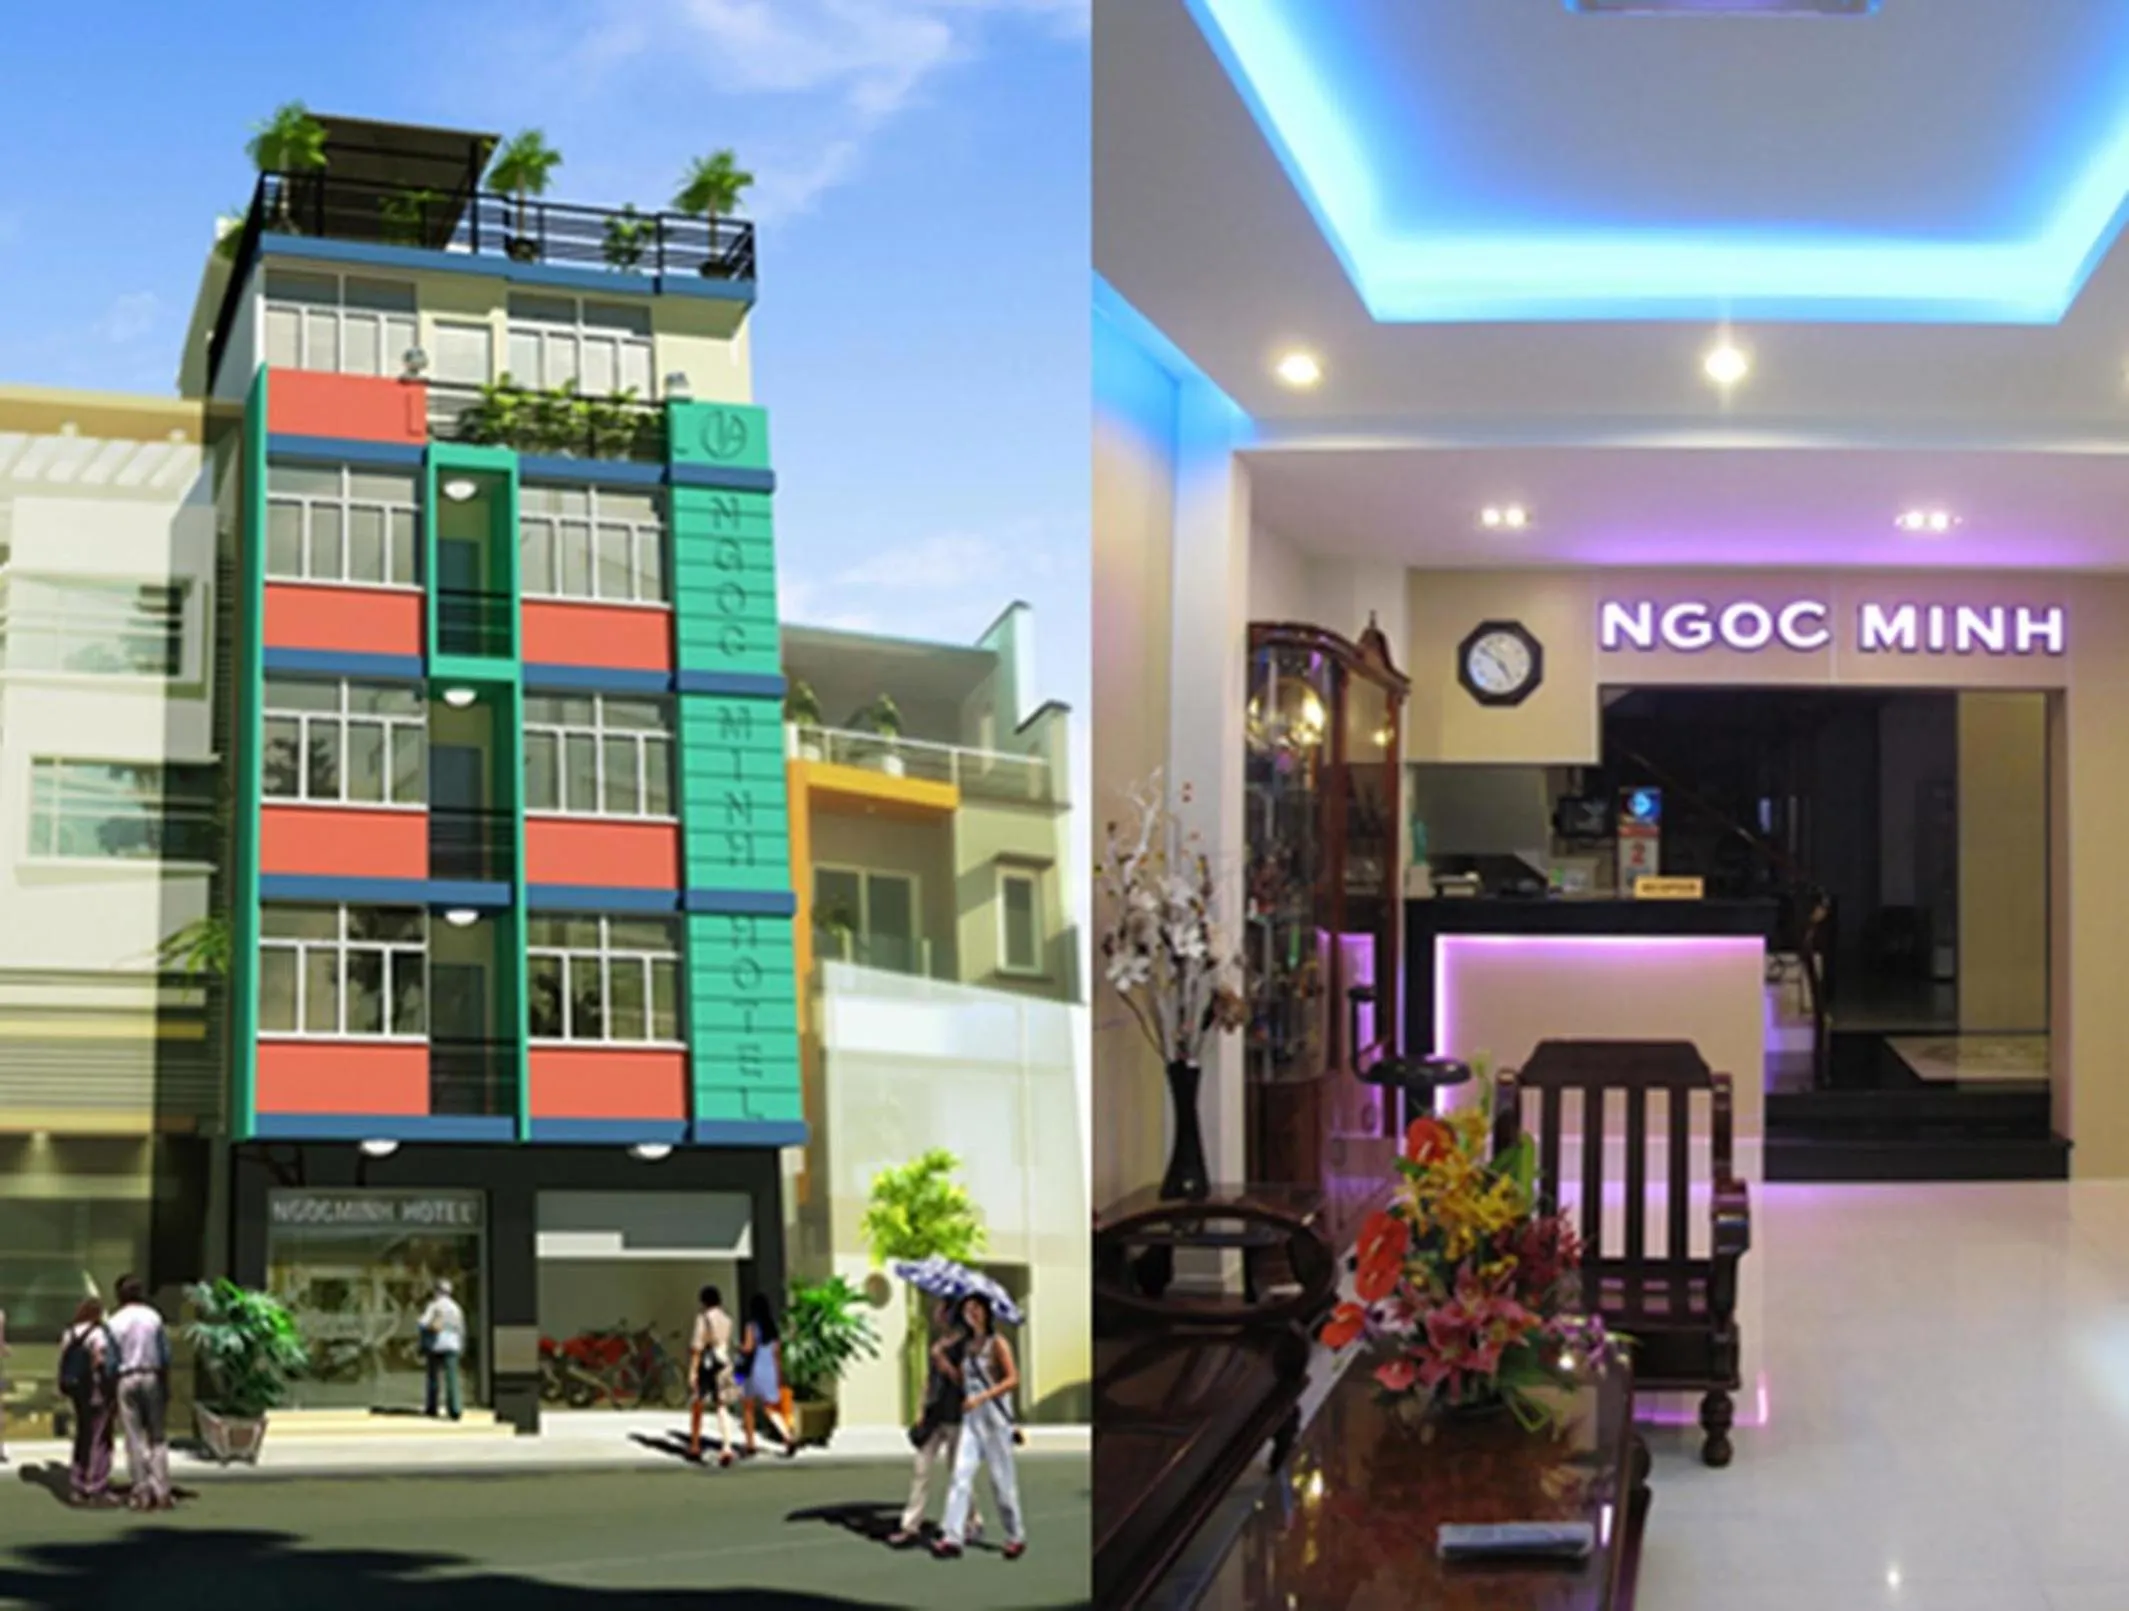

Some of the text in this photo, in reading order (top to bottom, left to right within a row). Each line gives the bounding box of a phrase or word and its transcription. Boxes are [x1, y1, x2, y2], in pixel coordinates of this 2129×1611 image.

[1601, 600, 2065, 653] NGOC MINH
[712, 495, 765, 1121] NGOC MINH HOTEL
[402, 1200, 478, 1224] HOTEL
